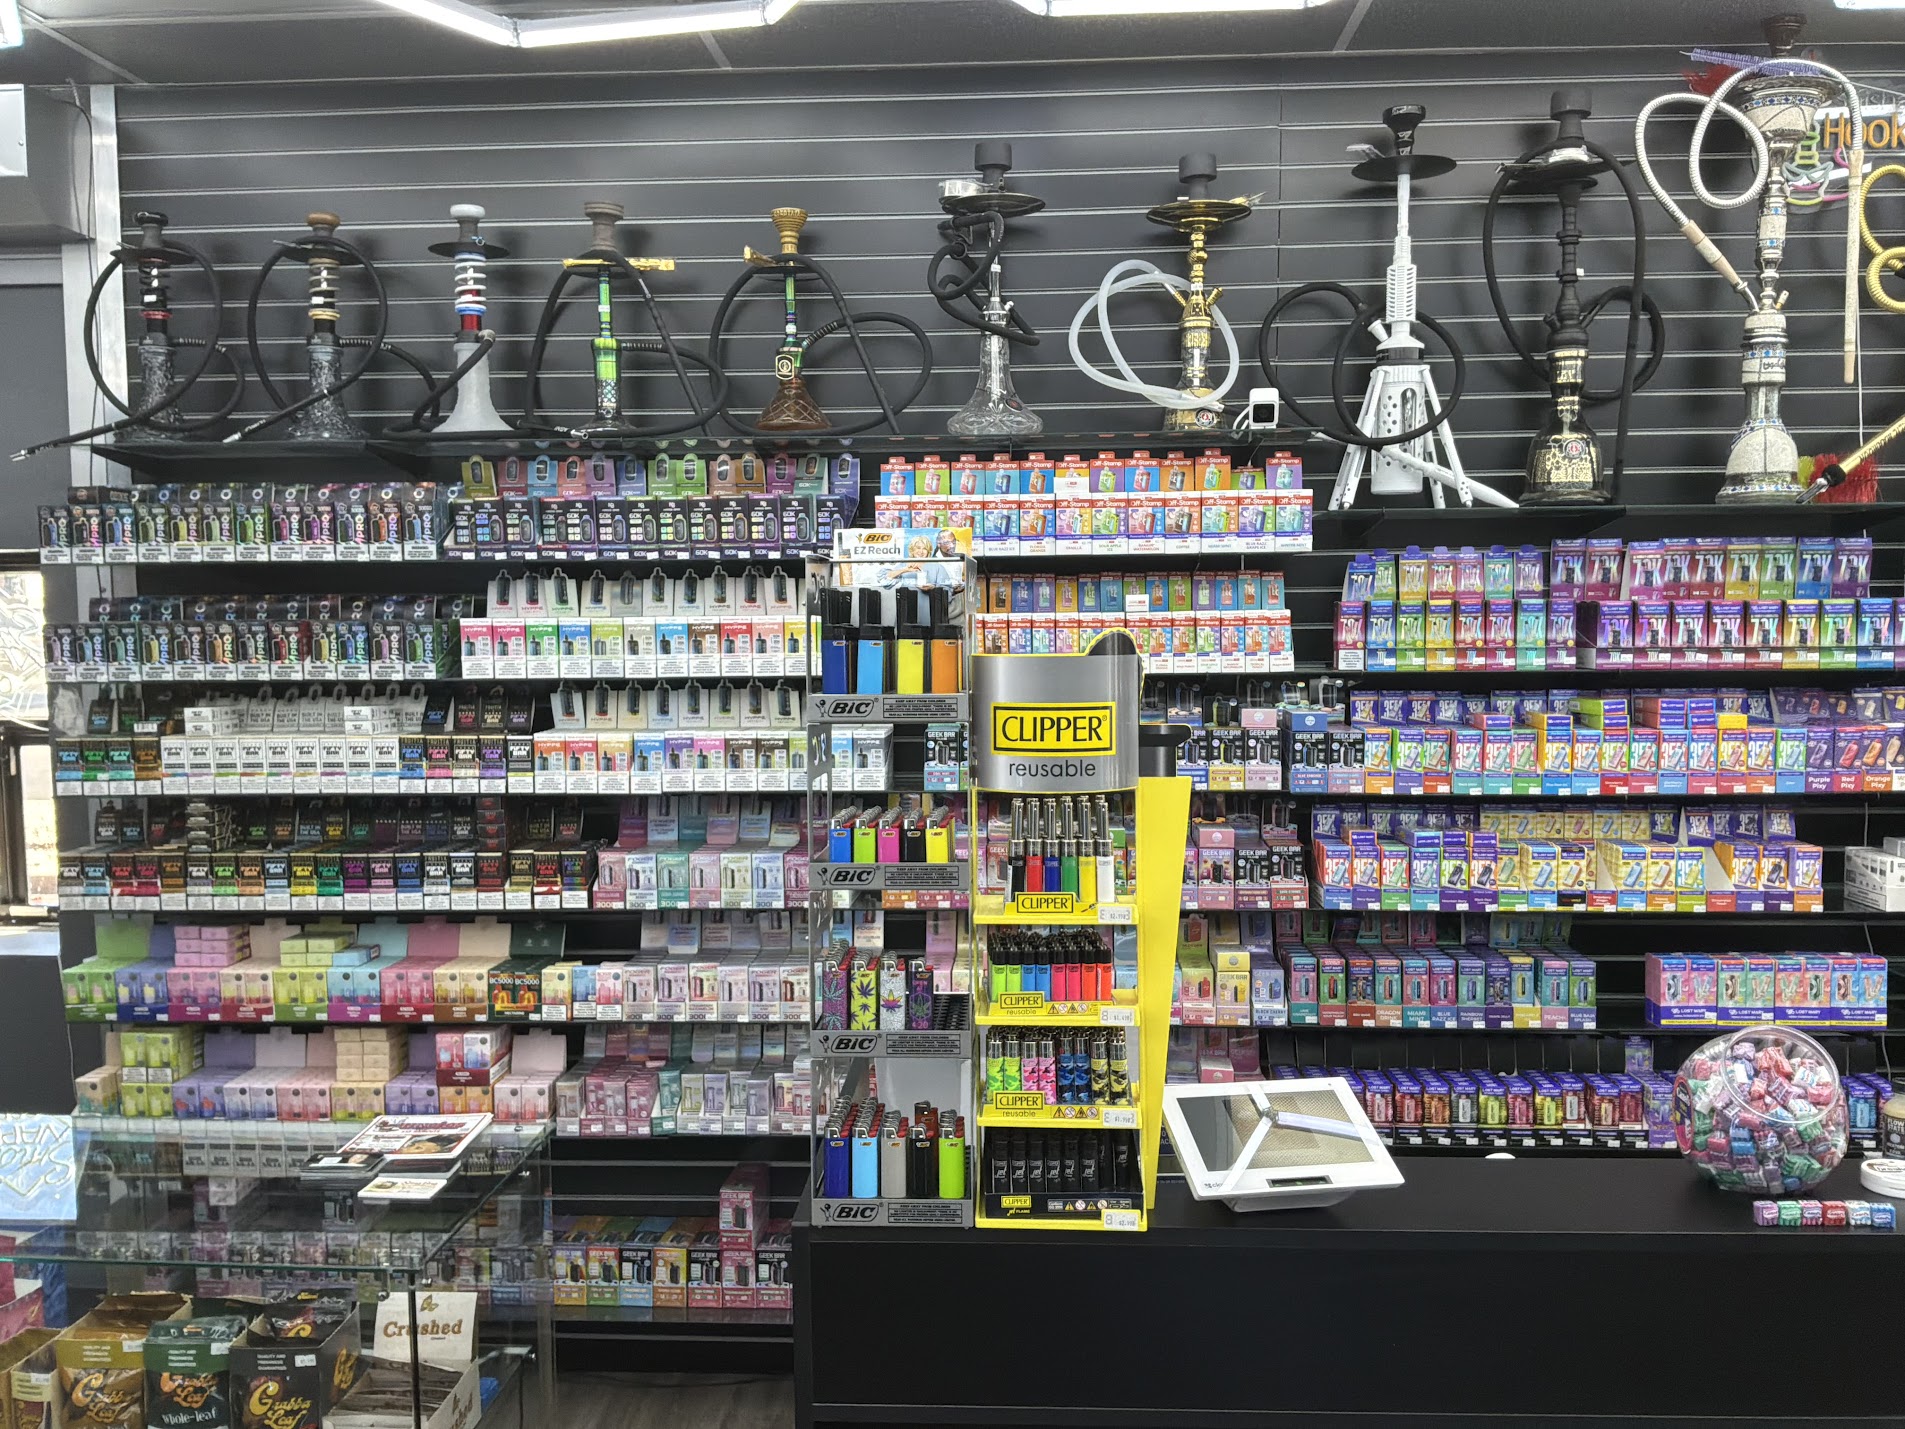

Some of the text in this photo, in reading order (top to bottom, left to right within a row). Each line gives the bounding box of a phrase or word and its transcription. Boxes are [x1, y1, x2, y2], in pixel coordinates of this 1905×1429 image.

[877, 503, 909, 511] Off-Stamp
[986, 502, 1017, 510] Off-Stamp
[1058, 501, 1090, 509] Off-Stamp
[854, 546, 900, 555] EZ Reach
[1002, 716, 1103, 742] CLIPPER
[1009, 760, 1096, 777] reusable
[1021, 897, 1068, 909] CLIPPER
[489, 977, 514, 985] BC5000
[1004, 996, 1039, 1006] CLIPPER
[999, 1096, 1039, 1106] CLIPPER
[161, 1406, 217, 1426] Whole-leaf
